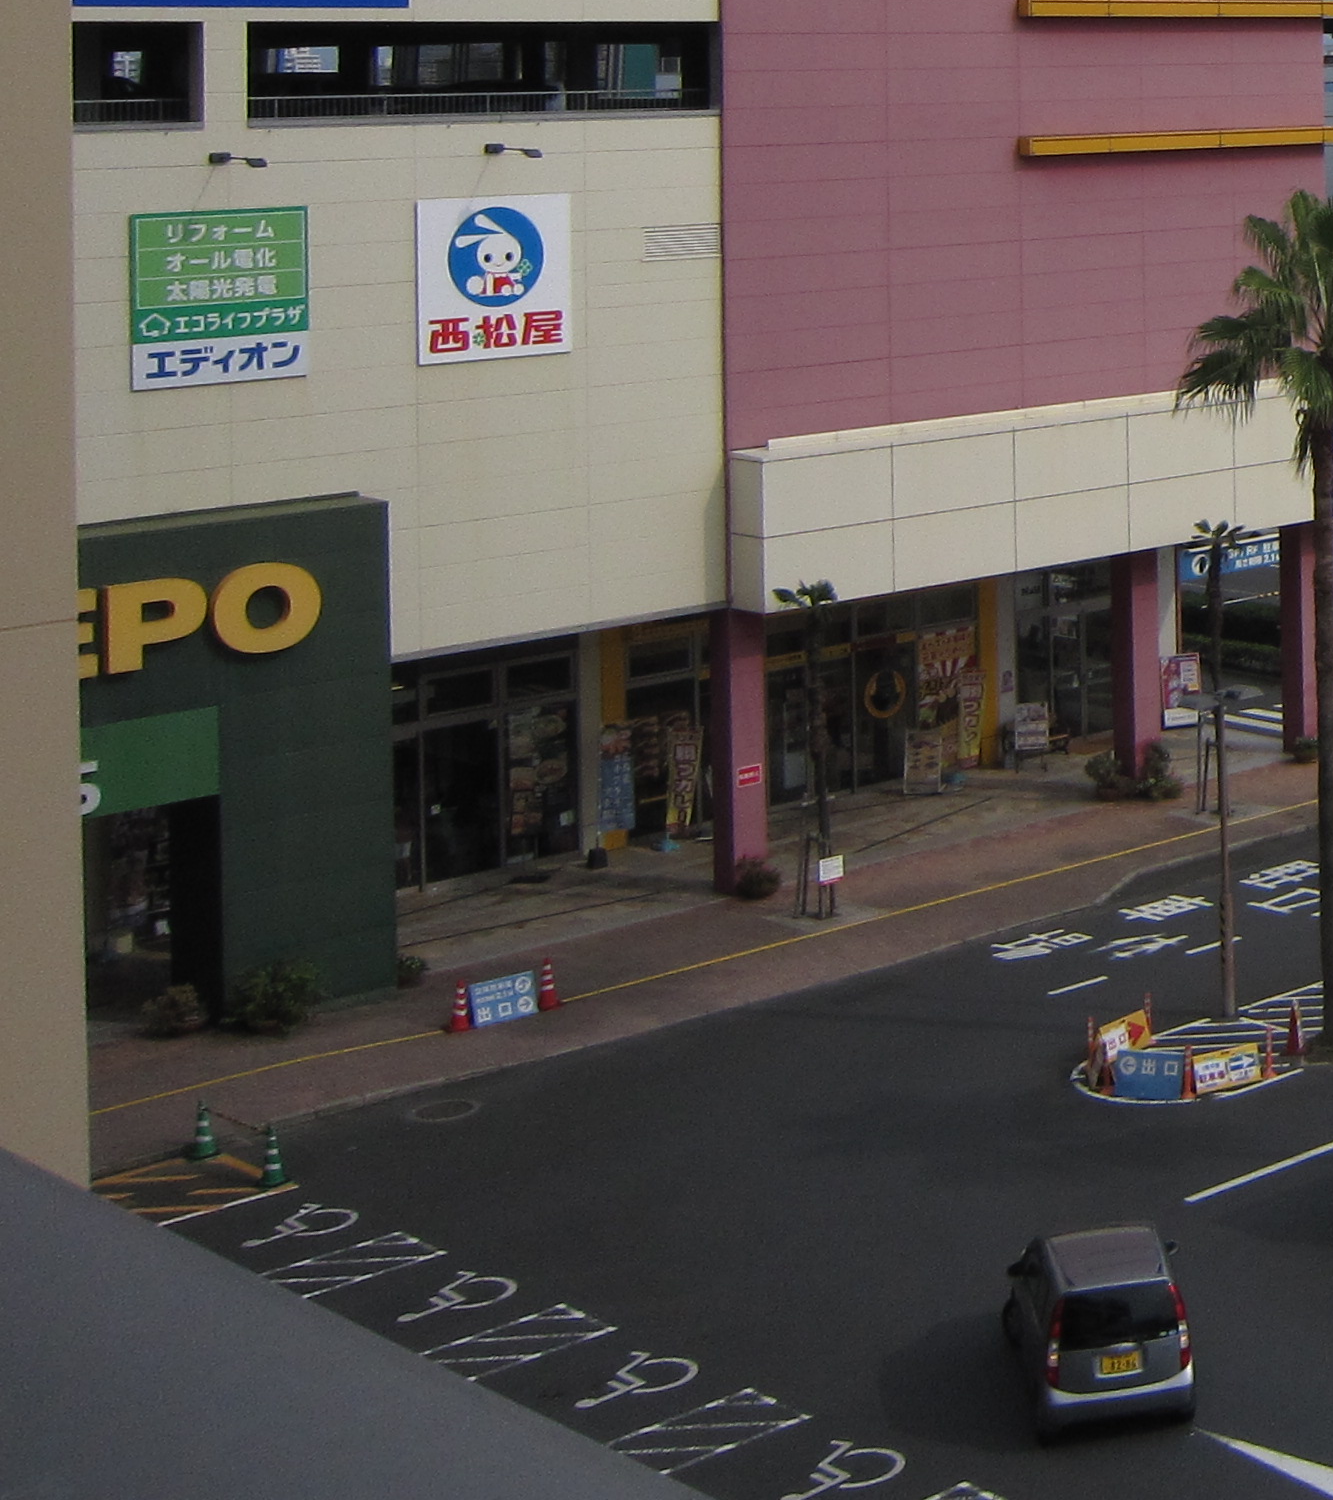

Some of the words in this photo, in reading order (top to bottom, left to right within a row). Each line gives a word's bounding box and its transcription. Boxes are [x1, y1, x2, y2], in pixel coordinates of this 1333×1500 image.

[167, 220, 275, 243] リフォーム
[166, 247, 276, 272] オール電化
[166, 275, 277, 301] 太陽光発電
[175, 305, 305, 333] エコライフプラザ
[428, 310, 563, 354] 西松屋
[146, 341, 300, 378] エディオン
[477, 1001, 512, 1022] 出口
[1141, 1059, 1179, 1076] 出口
